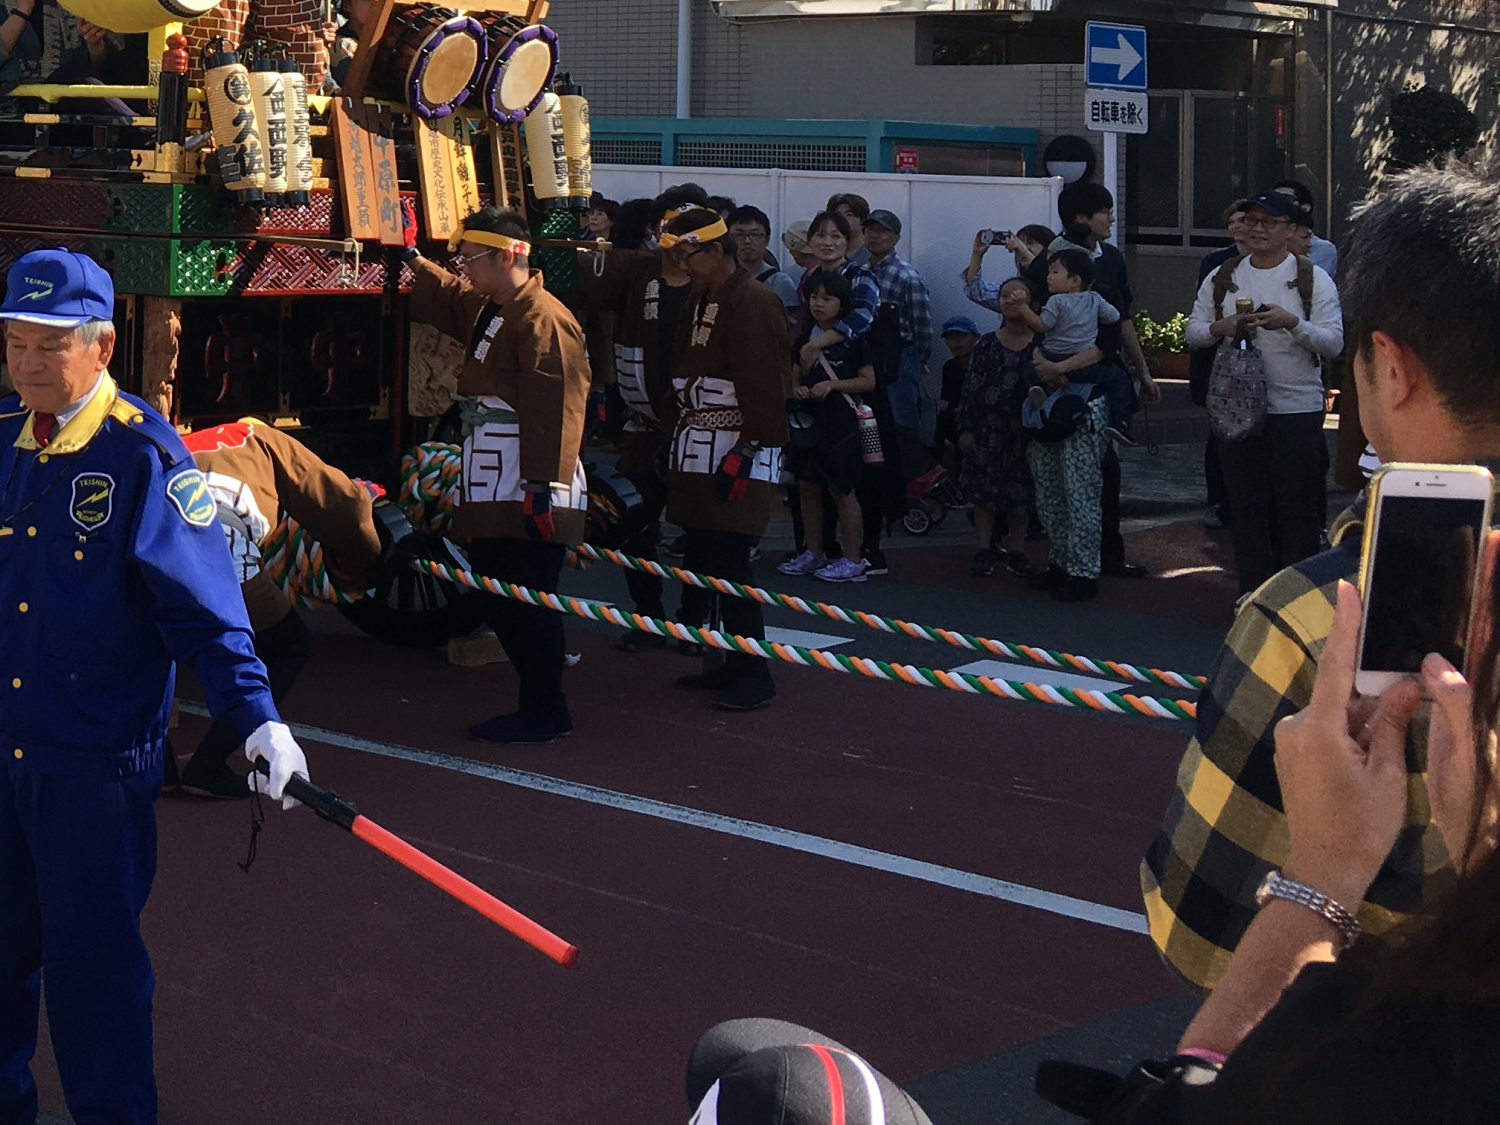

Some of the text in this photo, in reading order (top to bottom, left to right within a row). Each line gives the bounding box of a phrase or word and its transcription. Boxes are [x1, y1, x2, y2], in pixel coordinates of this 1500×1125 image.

[1091, 99, 1144, 125] 自転車を除く
[24, 277, 54, 288] TEISHIN
[79, 479, 109, 488] TEISHIN
[173, 476, 201, 492] TEISHIN
